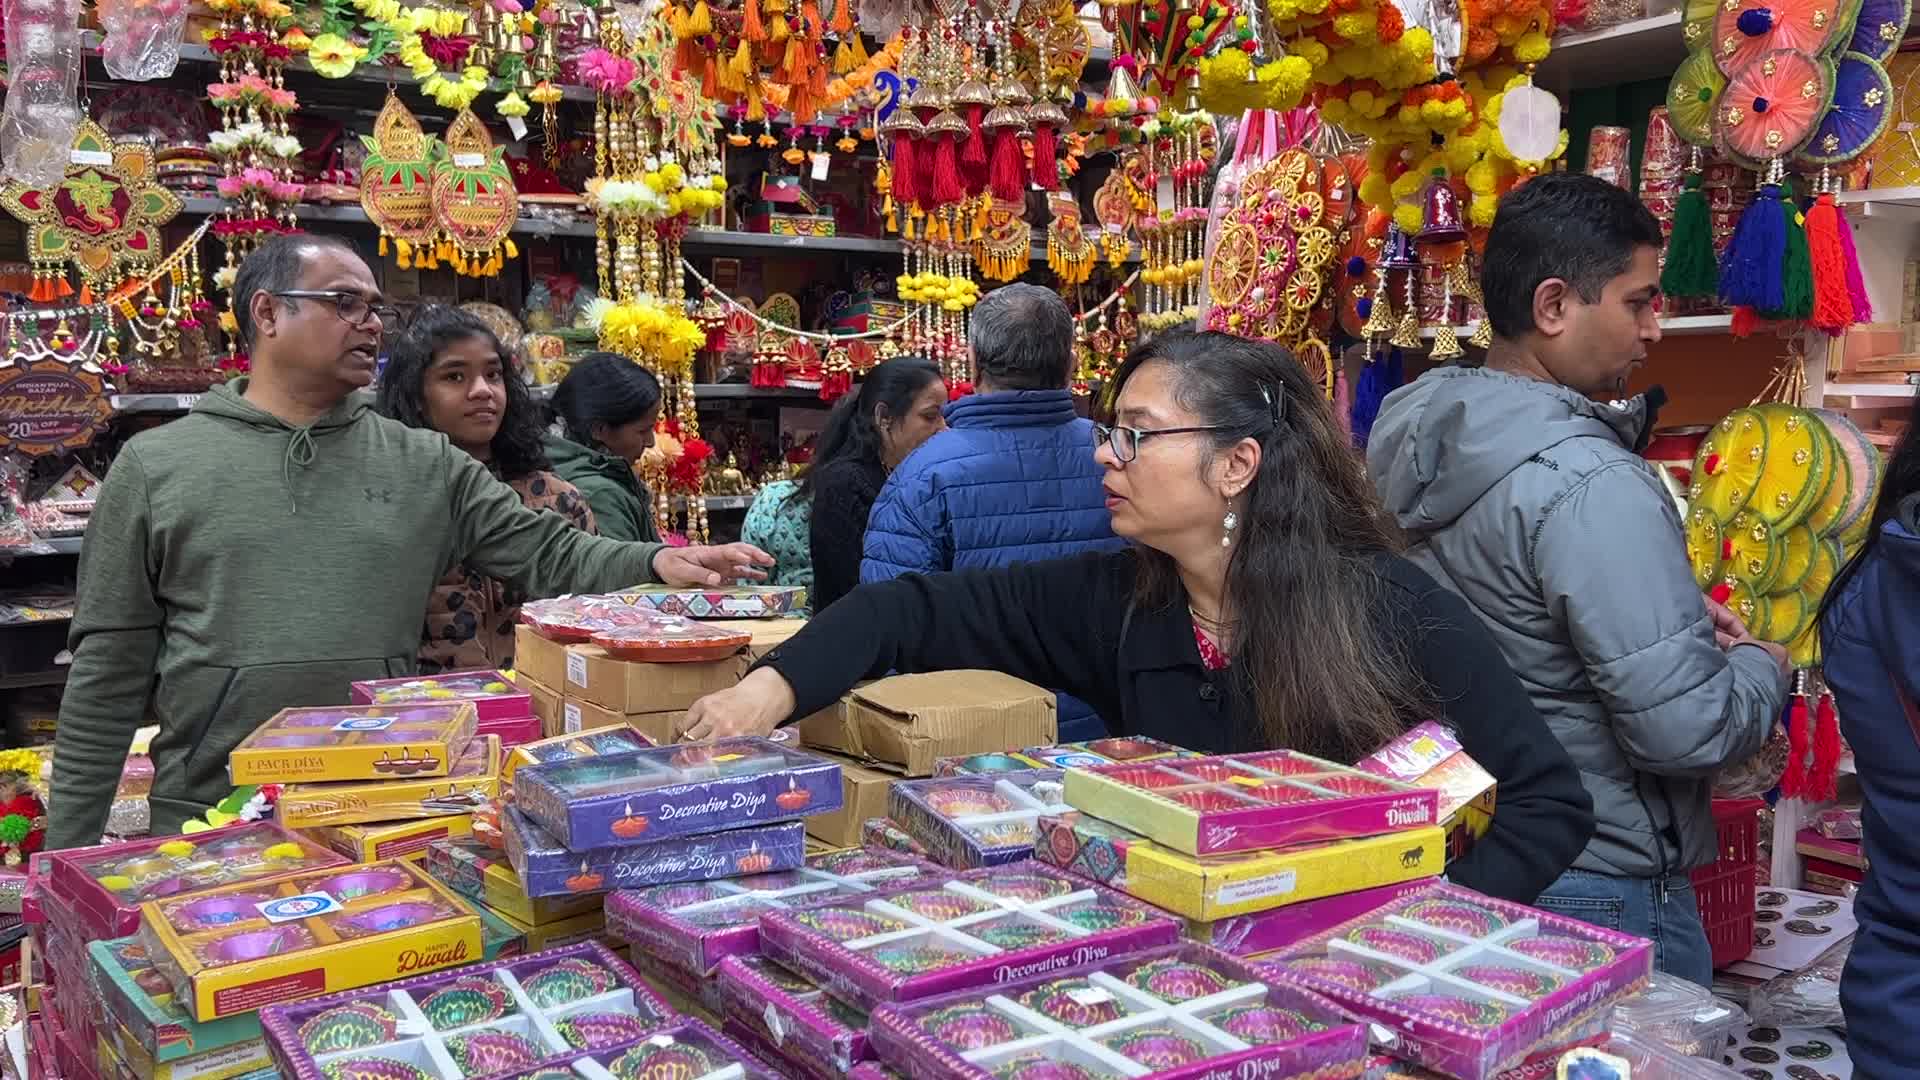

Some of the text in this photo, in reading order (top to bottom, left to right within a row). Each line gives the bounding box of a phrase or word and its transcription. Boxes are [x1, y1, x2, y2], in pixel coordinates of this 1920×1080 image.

[659, 791, 767, 820] Decorative Diya
[1384, 803, 1430, 827] Diwali
[614, 853, 726, 878] Decorative Diya
[397, 938, 469, 973] Diwali
[993, 945, 1108, 983] Decorative Diya
